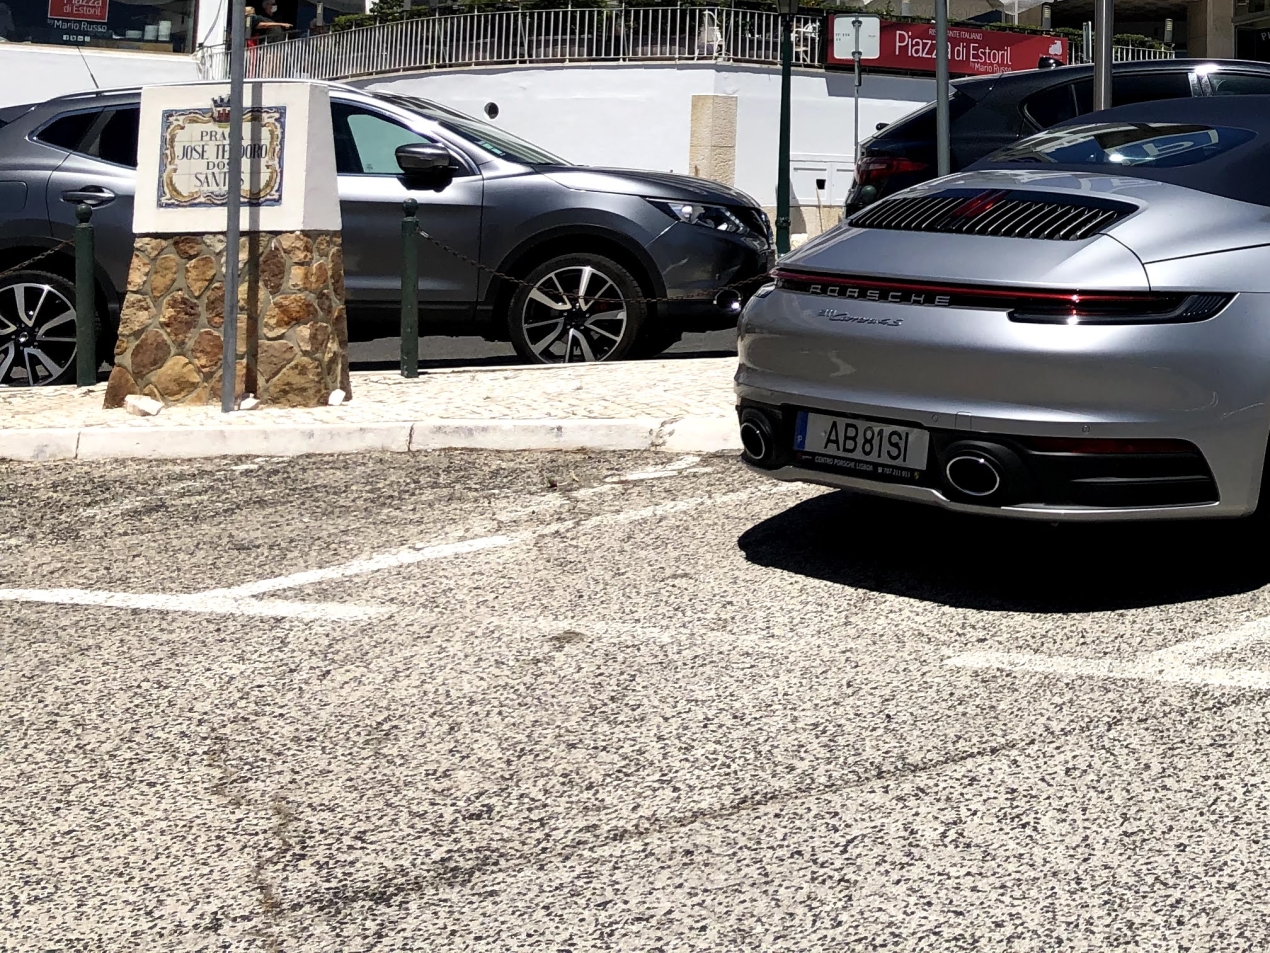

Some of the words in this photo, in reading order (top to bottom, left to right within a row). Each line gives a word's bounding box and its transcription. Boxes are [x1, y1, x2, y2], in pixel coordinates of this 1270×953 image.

[63, 5, 72, 13] di
[73, 5, 102, 16] Estoril
[54, 20, 80, 31] Mario
[81, 23, 108, 32] Russo
[960, 31, 983, 40] ITALIANO
[955, 41, 966, 61] di
[970, 43, 1012, 65] Estoril
[974, 63, 992, 73] Mario
[214, 144, 268, 160] TEDORO
[809, 284, 951, 306] PORSCHE
[824, 420, 909, 463] AB81SI
[814, 455, 834, 465] CENTRO
[833, 458, 856, 469] PORSCHE
[855, 463, 874, 472] LISBOA
